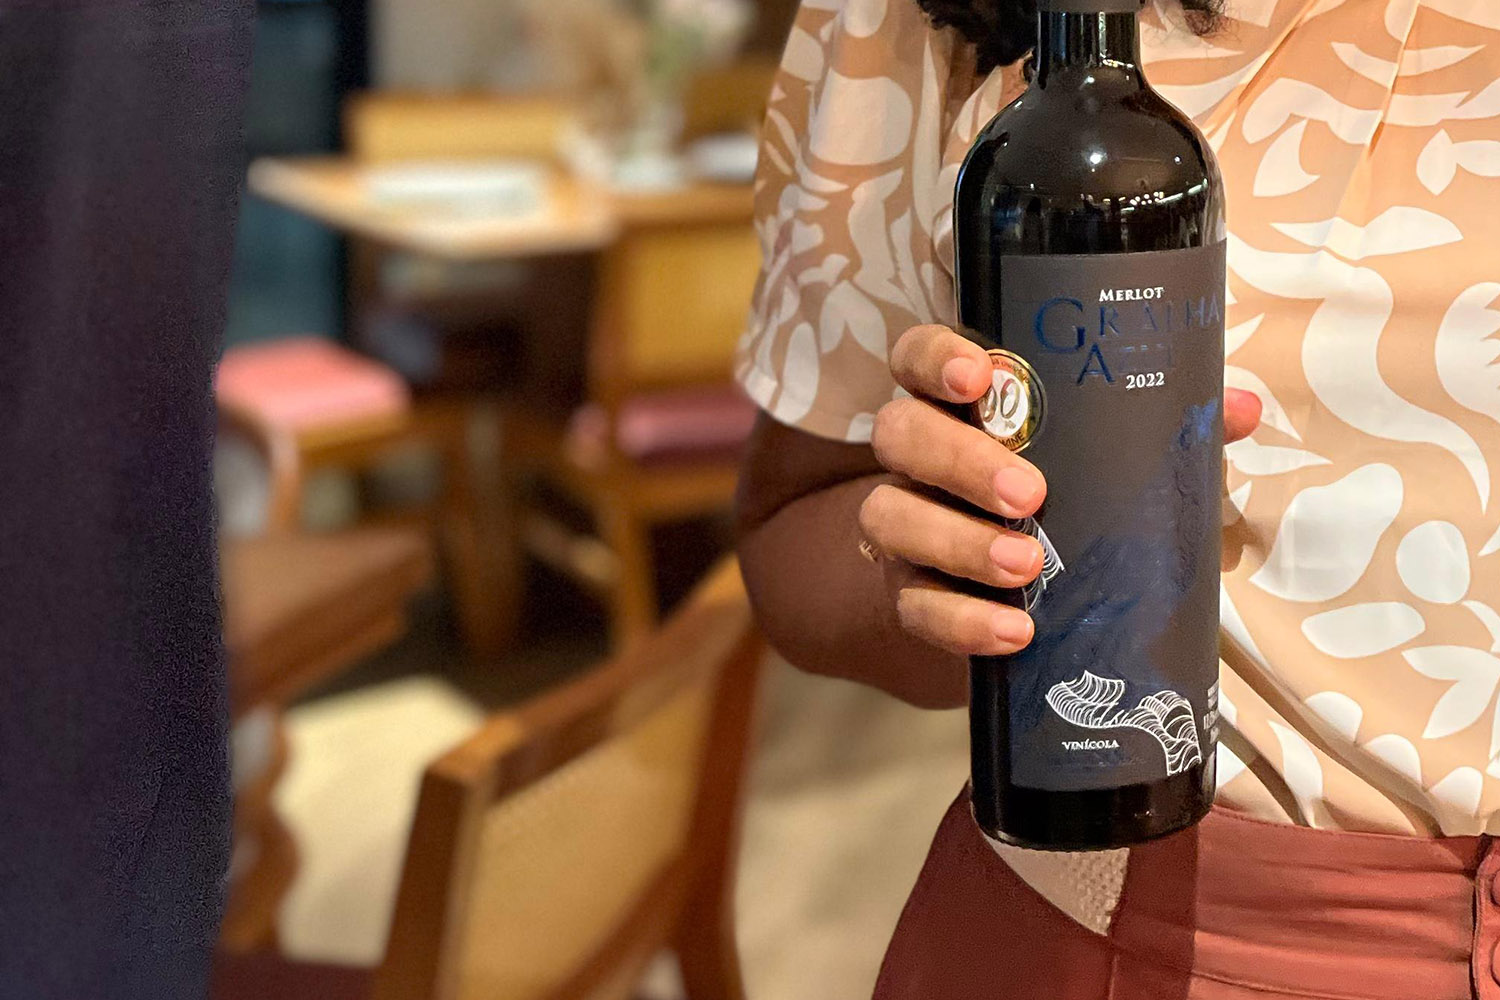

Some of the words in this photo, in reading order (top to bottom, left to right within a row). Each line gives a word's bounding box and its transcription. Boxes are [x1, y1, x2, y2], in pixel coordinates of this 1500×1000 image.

[1099, 286, 1164, 302] MERLOT
[1125, 372, 1165, 390] 2022
[1061, 738, 1120, 751] VINÍCOLA
